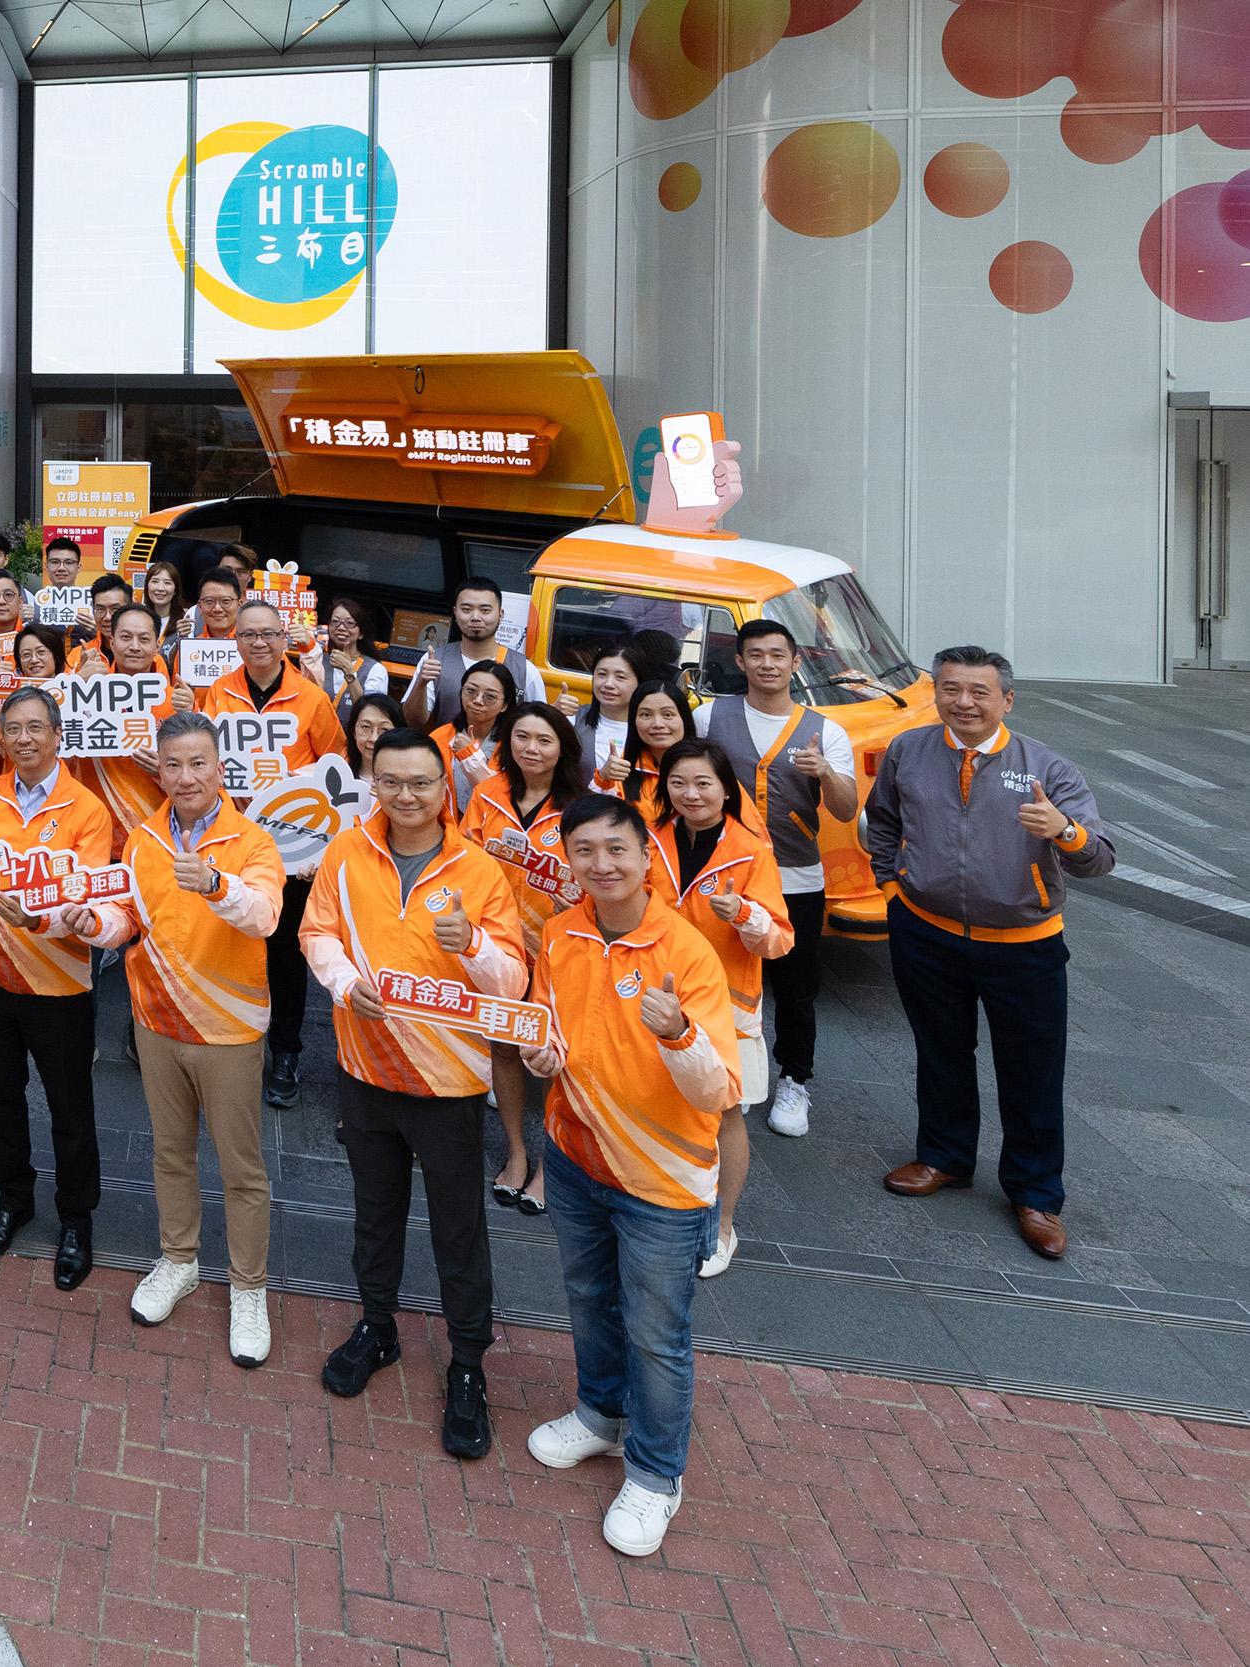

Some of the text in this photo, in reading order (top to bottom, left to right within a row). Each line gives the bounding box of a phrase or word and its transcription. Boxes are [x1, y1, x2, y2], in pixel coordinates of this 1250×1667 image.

[259, 157, 366, 180] Scramble
[258, 183, 366, 225] HILL
[255, 227, 365, 269] 三布目
[407, 452, 532, 466] eMPF Registration Van
[256, 816, 329, 843] MPFA
